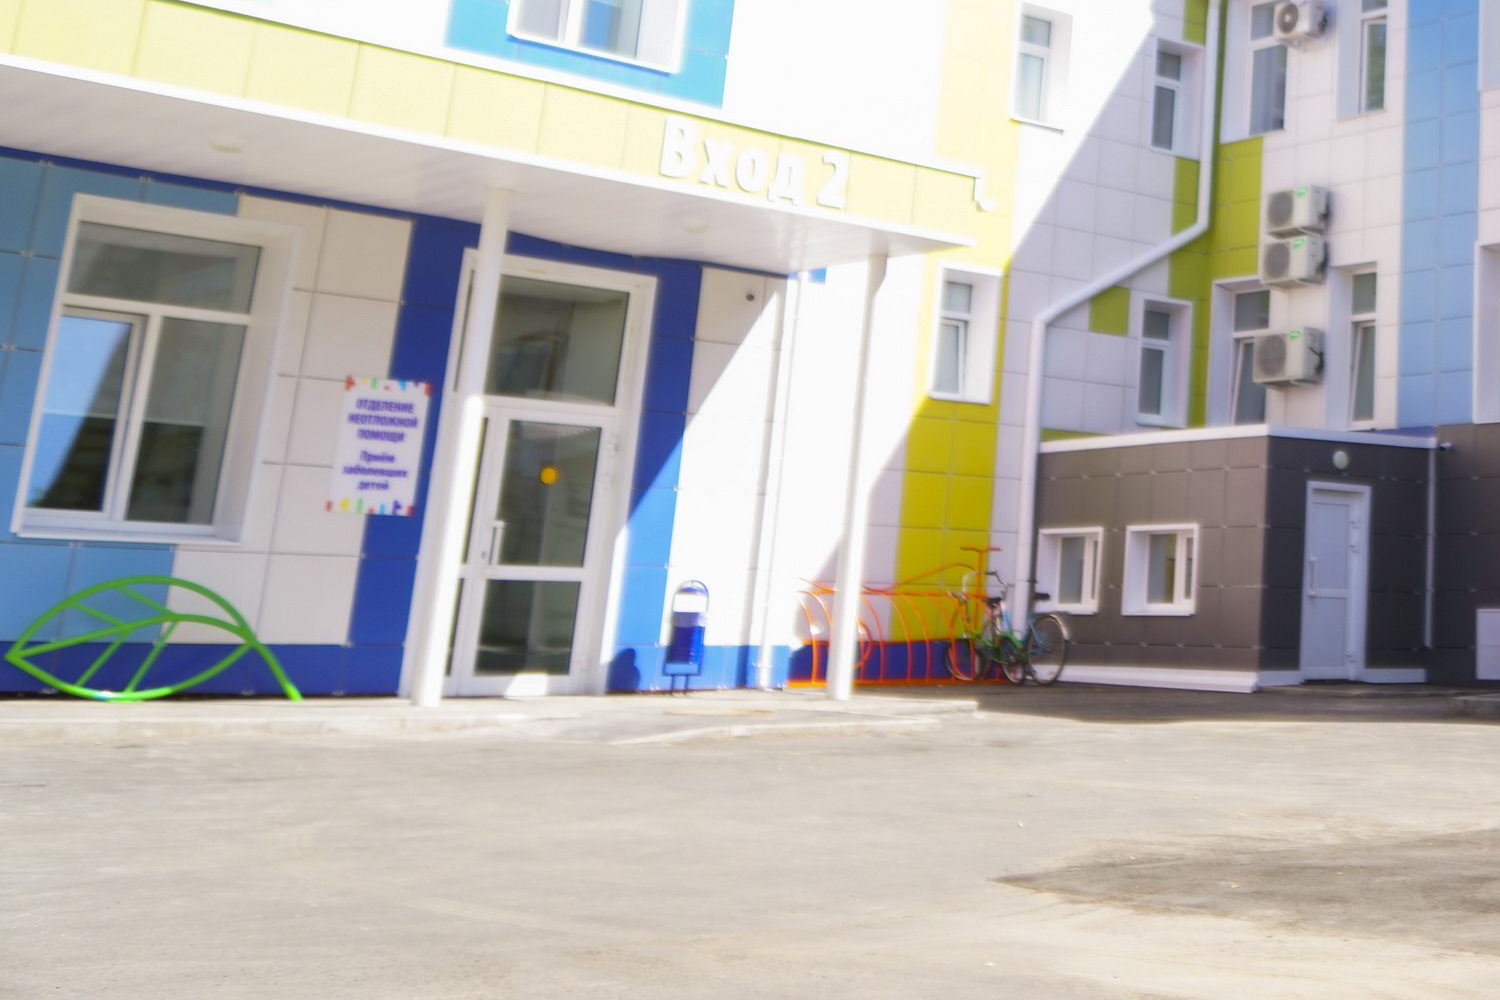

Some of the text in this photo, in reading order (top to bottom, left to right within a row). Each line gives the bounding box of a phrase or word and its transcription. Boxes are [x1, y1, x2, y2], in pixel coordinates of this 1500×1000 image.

[659, 115, 850, 210] Вход 2
[356, 399, 415, 412] ОТДЕЛЕНИЕ
[347, 413, 418, 428] НЕОТЛОЖНОЙ
[357, 429, 405, 442] ПОМОЩИ
